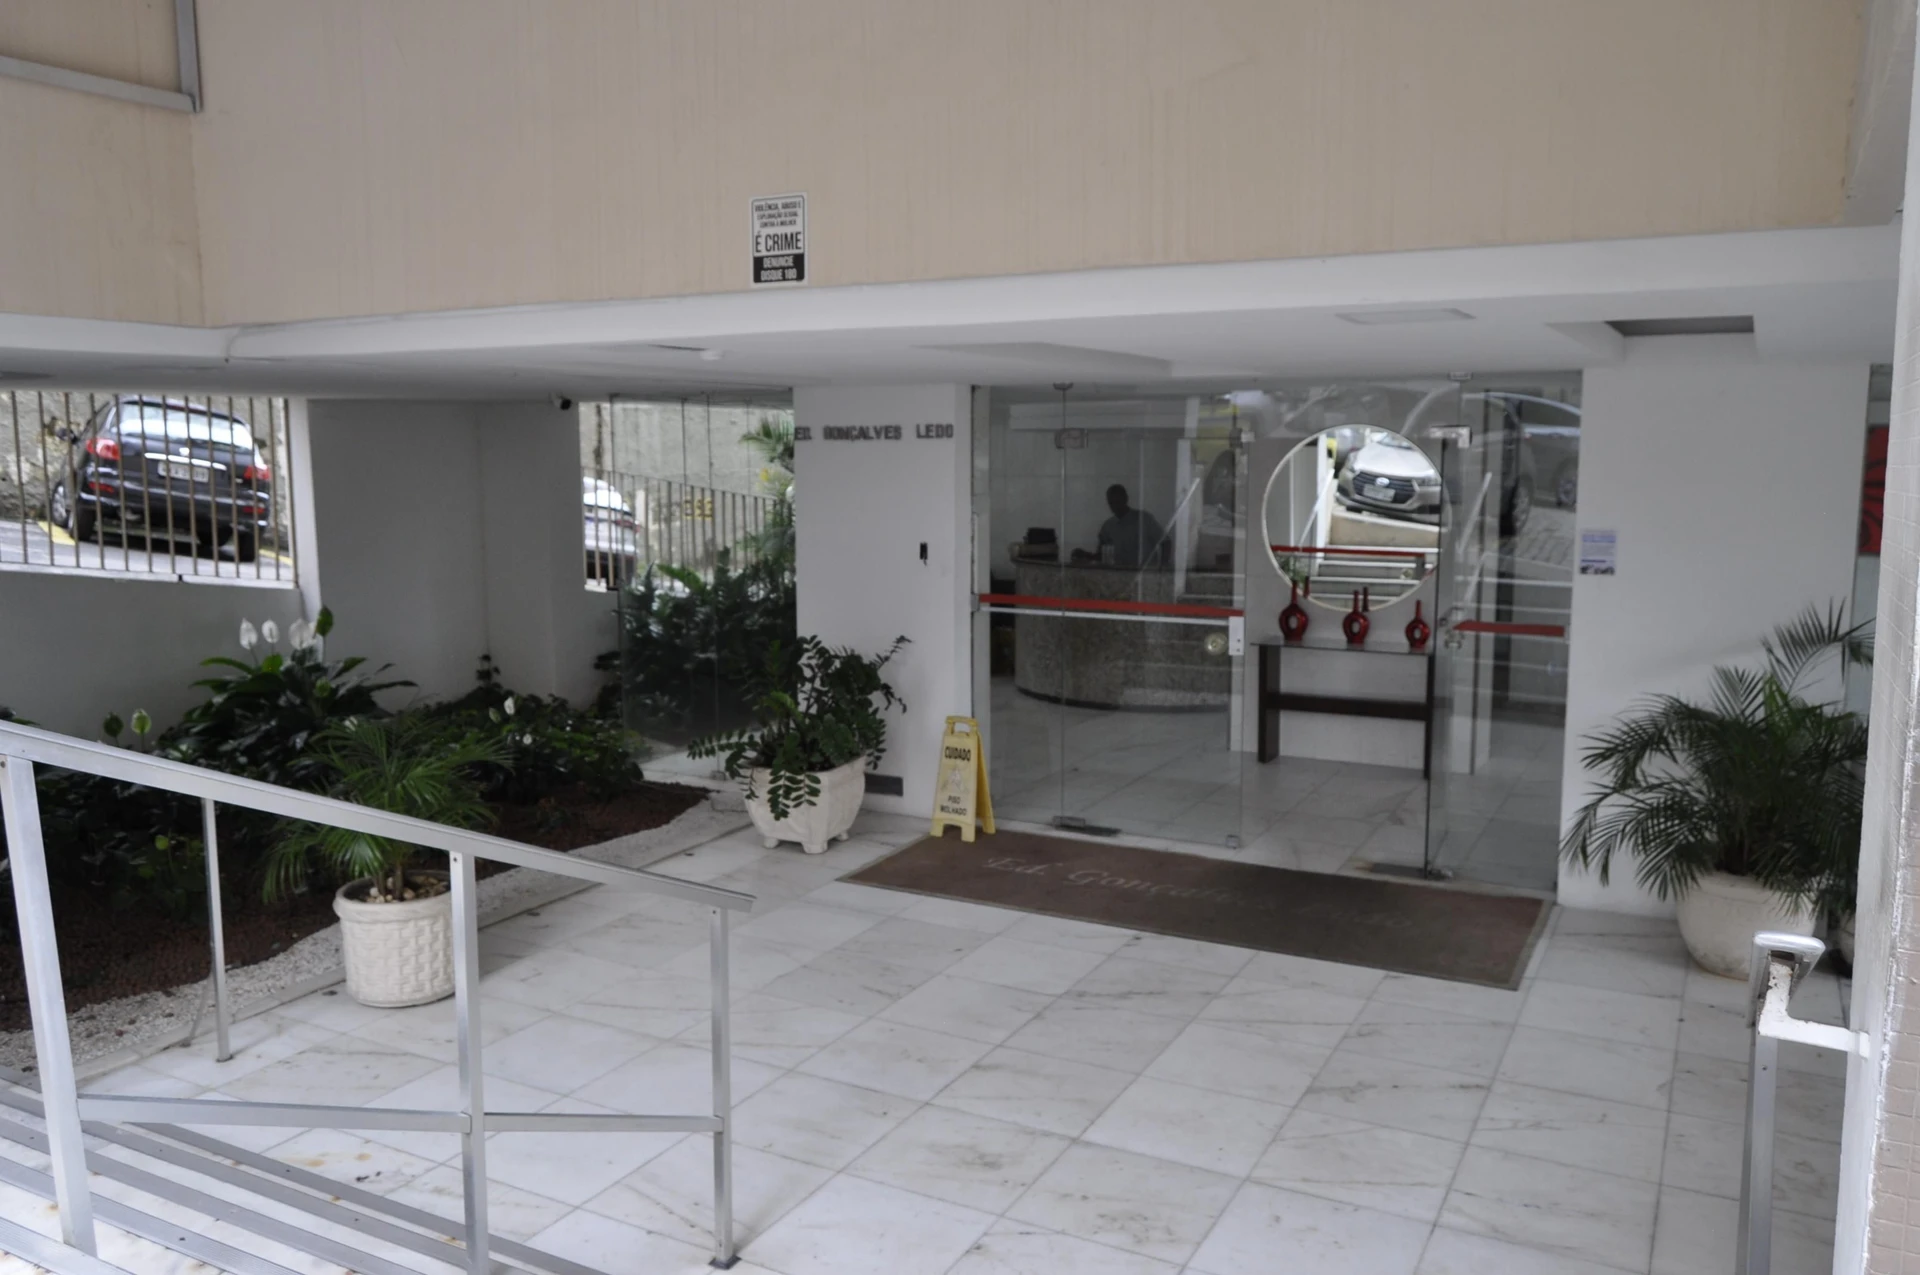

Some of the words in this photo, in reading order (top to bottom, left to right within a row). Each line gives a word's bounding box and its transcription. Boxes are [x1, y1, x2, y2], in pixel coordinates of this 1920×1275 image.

[755, 230, 762, 253] É
[764, 231, 802, 252] CRIME
[760, 269, 783, 281] DISQUE
[916, 424, 954, 439] LEDO
[944, 746, 972, 762] CUIDADO
[948, 795, 962, 805] PISO
[940, 804, 968, 816] MOLHADO
